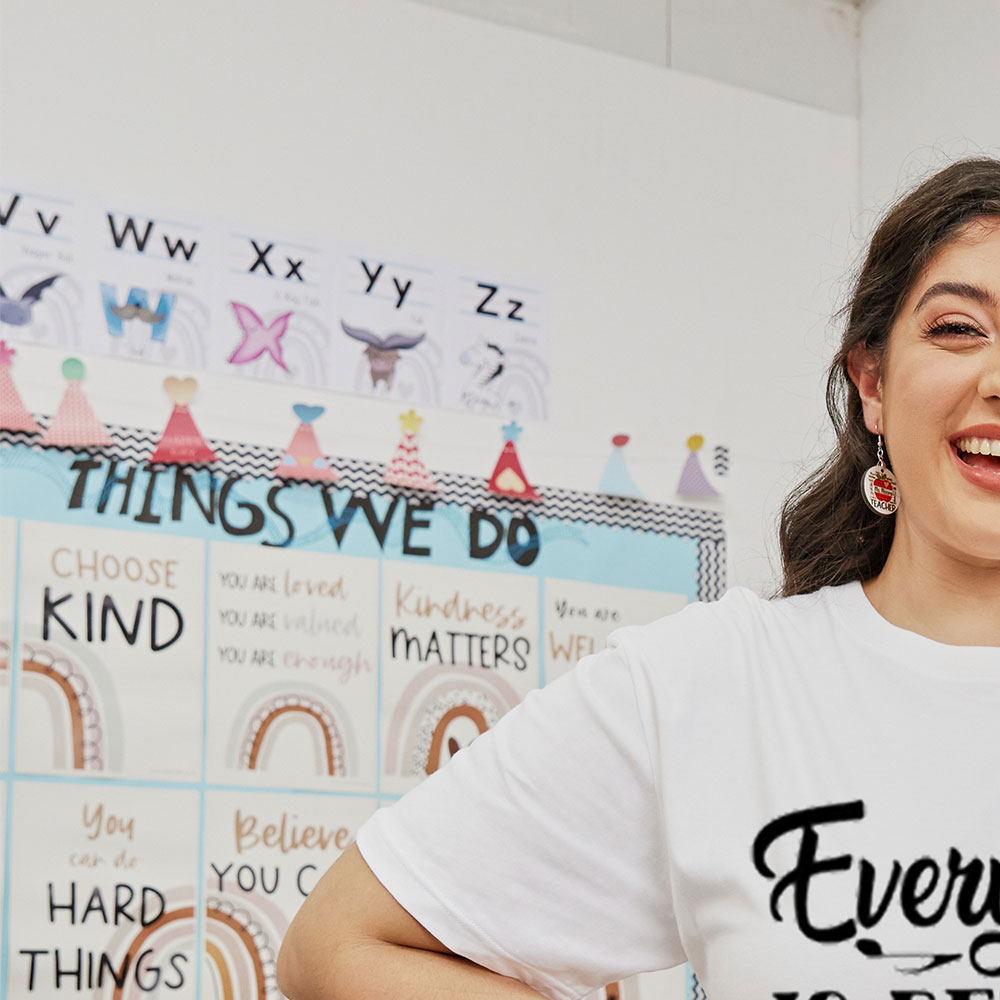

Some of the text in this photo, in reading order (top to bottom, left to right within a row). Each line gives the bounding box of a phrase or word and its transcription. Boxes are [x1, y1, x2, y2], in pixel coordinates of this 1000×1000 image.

[68, 458, 540, 568] THINGS WE DO
[51, 547, 179, 589] CHOOSE
[219, 568, 348, 602] YOU ARE loved
[42, 586, 184, 652] KIND
[218, 608, 248, 628] YOU
[252, 610, 277, 631] ARE
[395, 580, 527, 631] Kindness
[218, 645, 373, 686] YOU ARE enough
[82, 803, 135, 840] You
[234, 808, 352, 854] Believe
[69, 848, 138, 869] can do
[211, 862, 279, 894] YOU
[48, 881, 166, 927] HARD
[19, 947, 189, 992] THINGS
